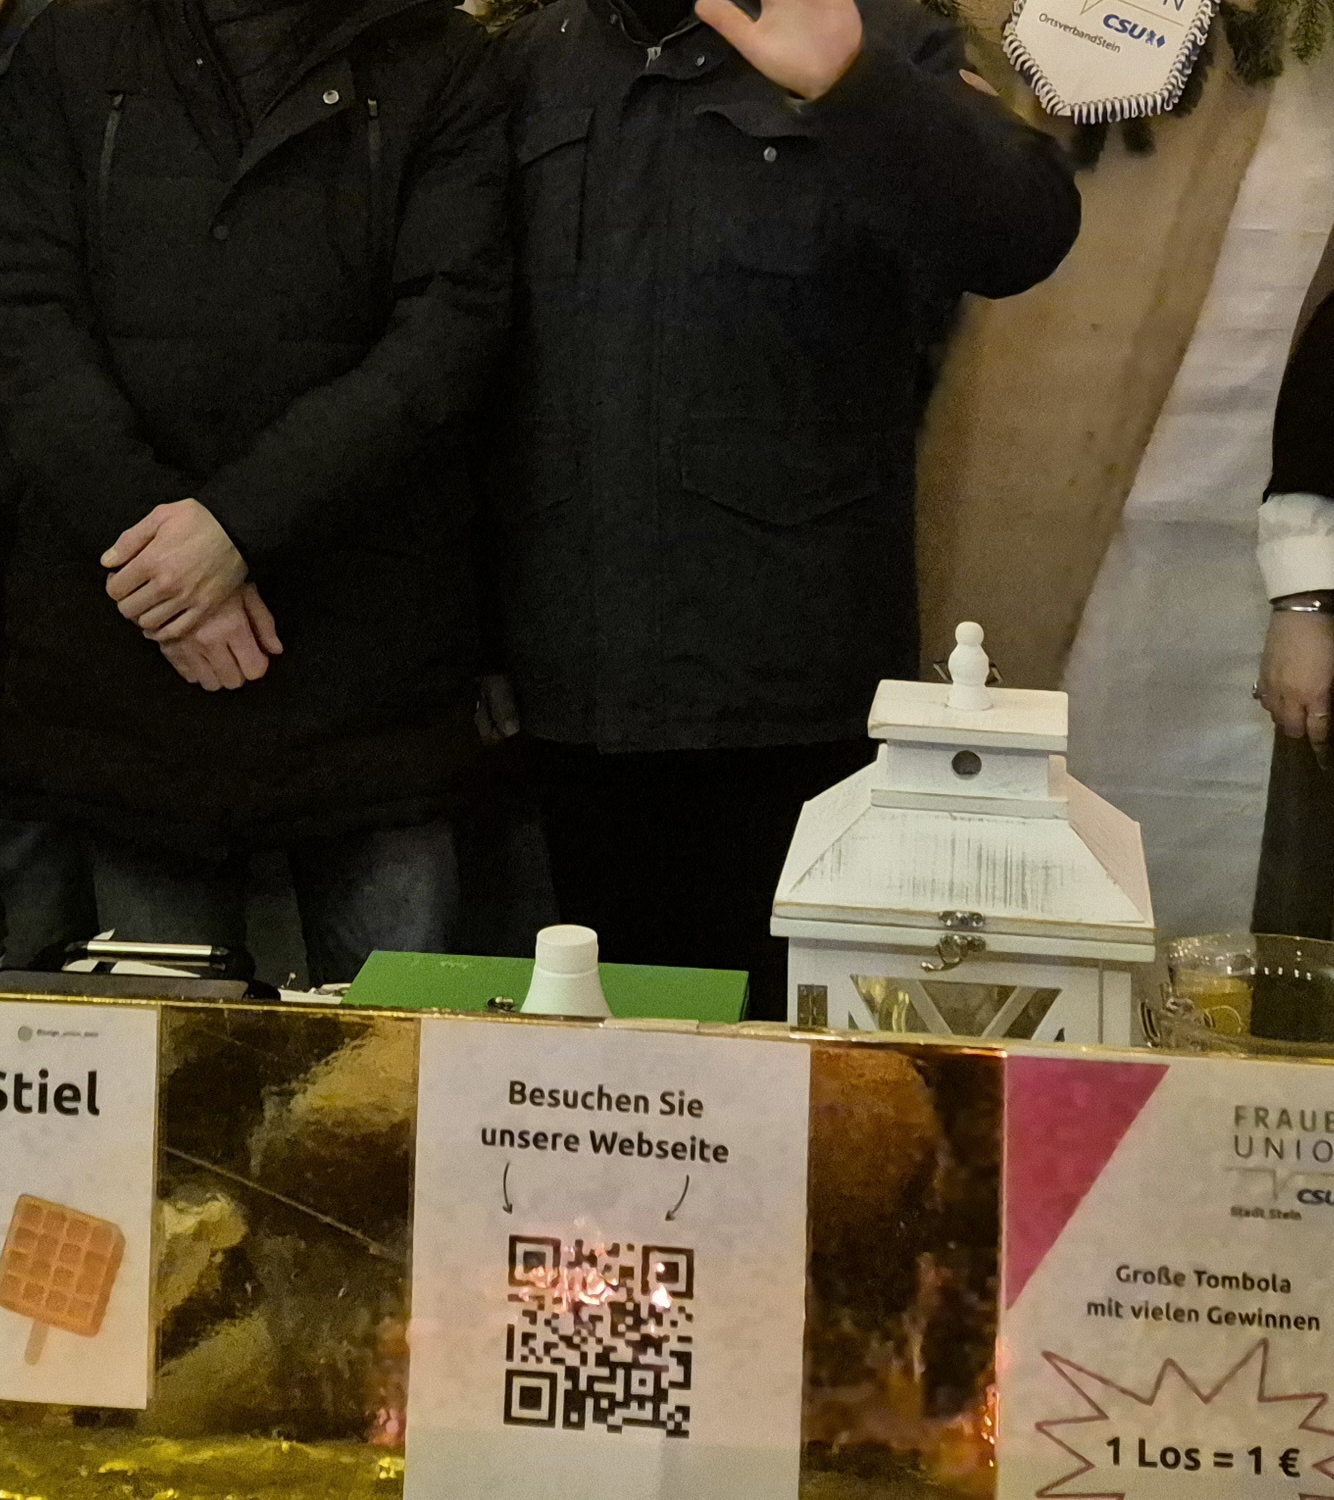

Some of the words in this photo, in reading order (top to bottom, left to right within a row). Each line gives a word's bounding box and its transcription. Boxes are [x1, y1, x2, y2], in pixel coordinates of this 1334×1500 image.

[1102, 13, 1147, 41] CSU
[509, 1080, 650, 1115] Besuchen
[659, 1090, 704, 1118] Sie
[481, 1126, 580, 1152] unsere
[589, 1130, 729, 1163] Webseite
[1116, 1265, 1186, 1287] Große
[1194, 1270, 1292, 1294] Tombola
[1087, 1299, 1123, 1318] mit
[1131, 1302, 1199, 1323] vielen
[1207, 1306, 1320, 1332] Gewinnen
[1106, 1437, 1121, 1466] 1
[1138, 1438, 1201, 1471] Los
[1213, 1452, 1233, 1469] =
[1247, 1447, 1263, 1474] 1
[1279, 1448, 1301, 1478] €
